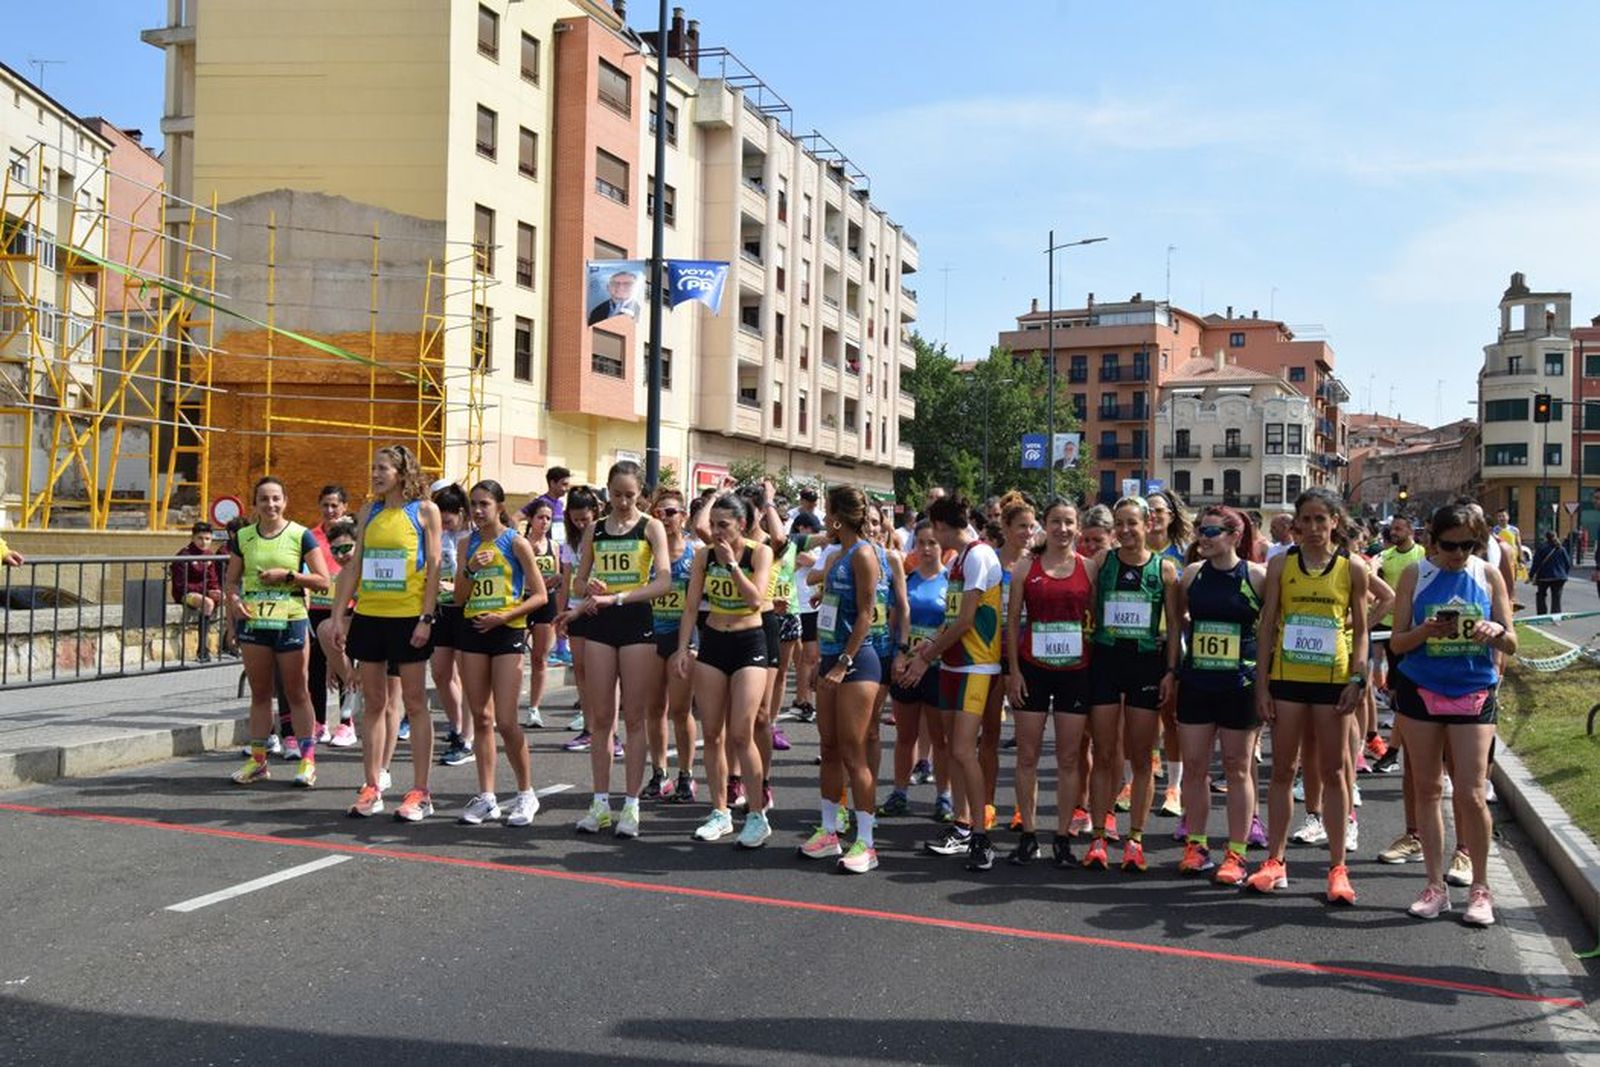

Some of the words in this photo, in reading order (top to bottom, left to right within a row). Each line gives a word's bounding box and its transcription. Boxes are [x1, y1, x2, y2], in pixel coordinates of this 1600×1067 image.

[678, 268, 714, 278] VOTA
[684, 278, 714, 291] PP
[601, 553, 630, 571] 116
[473, 579, 493, 597] 30
[711, 580, 742, 597] 20
[257, 602, 276, 617] 17
[1198, 636, 1229, 655] 161
